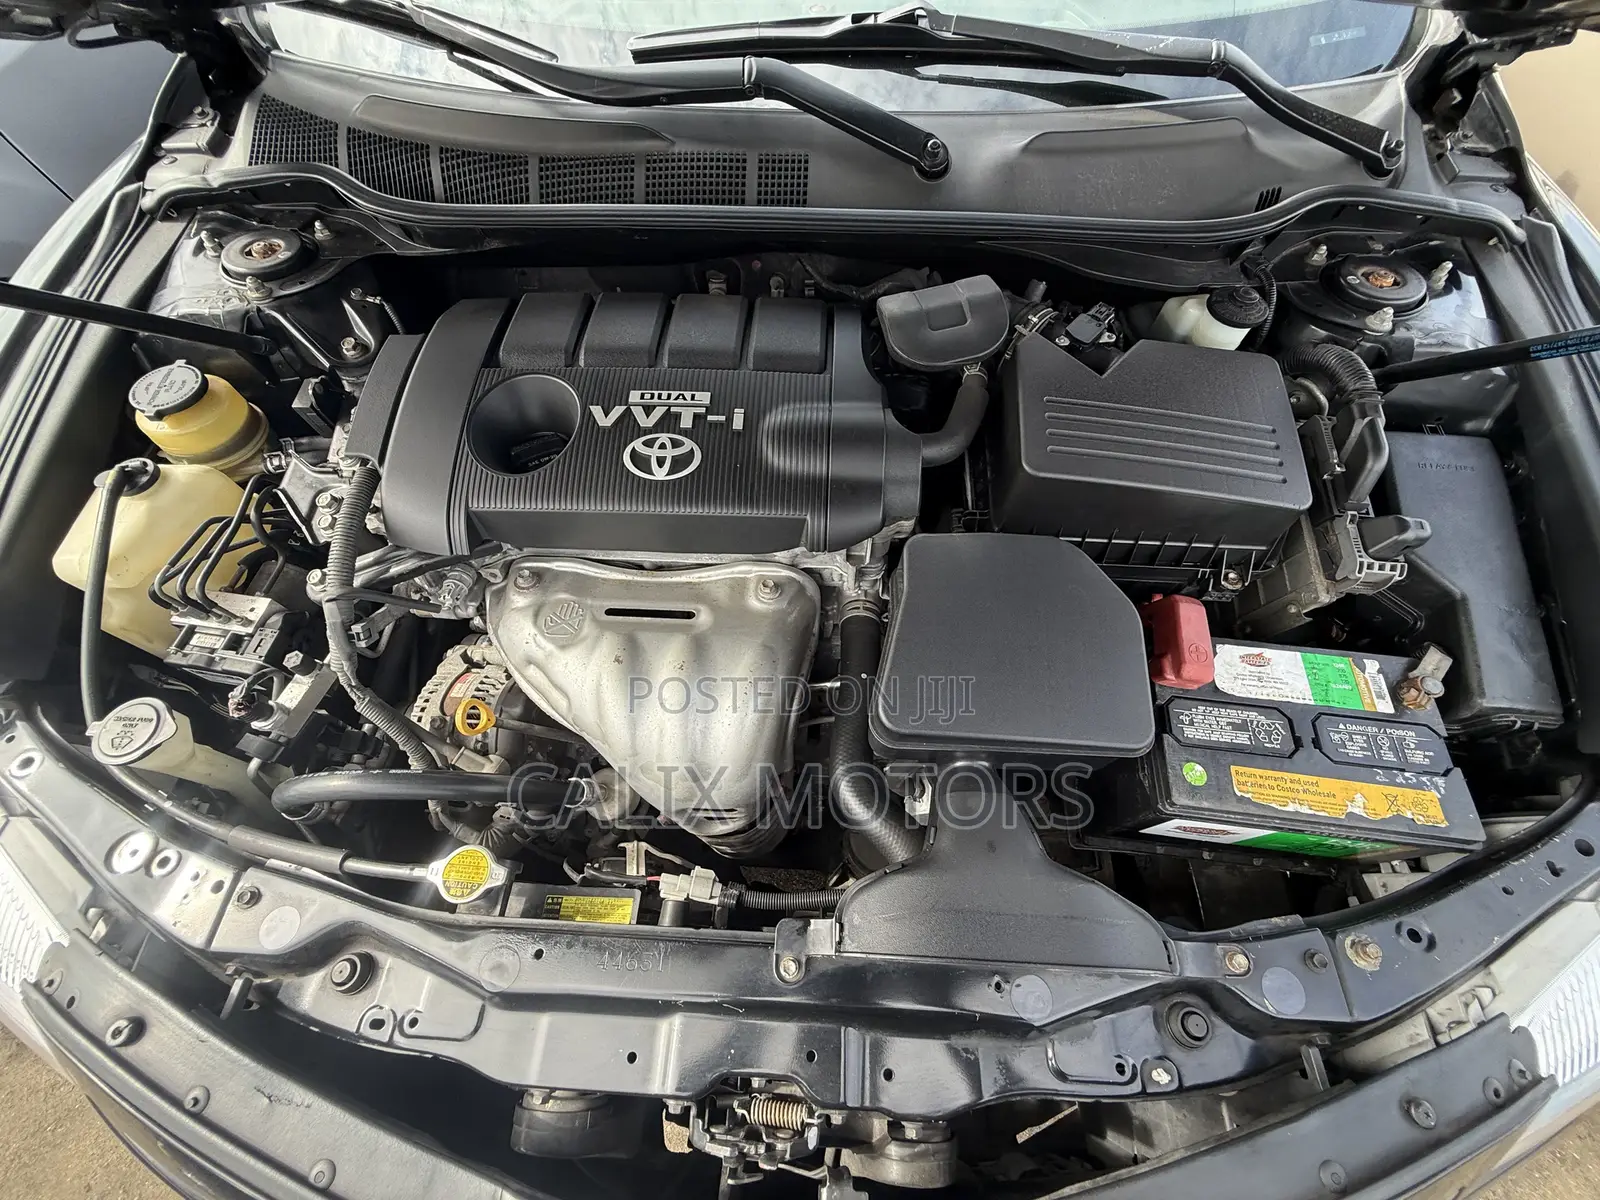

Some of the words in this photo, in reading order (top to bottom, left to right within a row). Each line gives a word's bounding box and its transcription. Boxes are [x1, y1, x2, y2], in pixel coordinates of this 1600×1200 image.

[640, 392, 703, 402] DUAL
[589, 405, 745, 432] VVT-i
[1239, 655, 1272, 663] INTERSTATE
[1346, 723, 1378, 733] DANGER
[1386, 728, 1416, 737] POISON
[1234, 770, 1258, 780] Return
[1258, 774, 1287, 785] warranty
[1289, 777, 1302, 786] and
[1303, 779, 1319, 788] used
[1268, 783, 1275, 791] to
[1276, 784, 1301, 794] Costco
[1302, 787, 1337, 799] Wholesale
[445, 880, 478, 890] CAUTION
